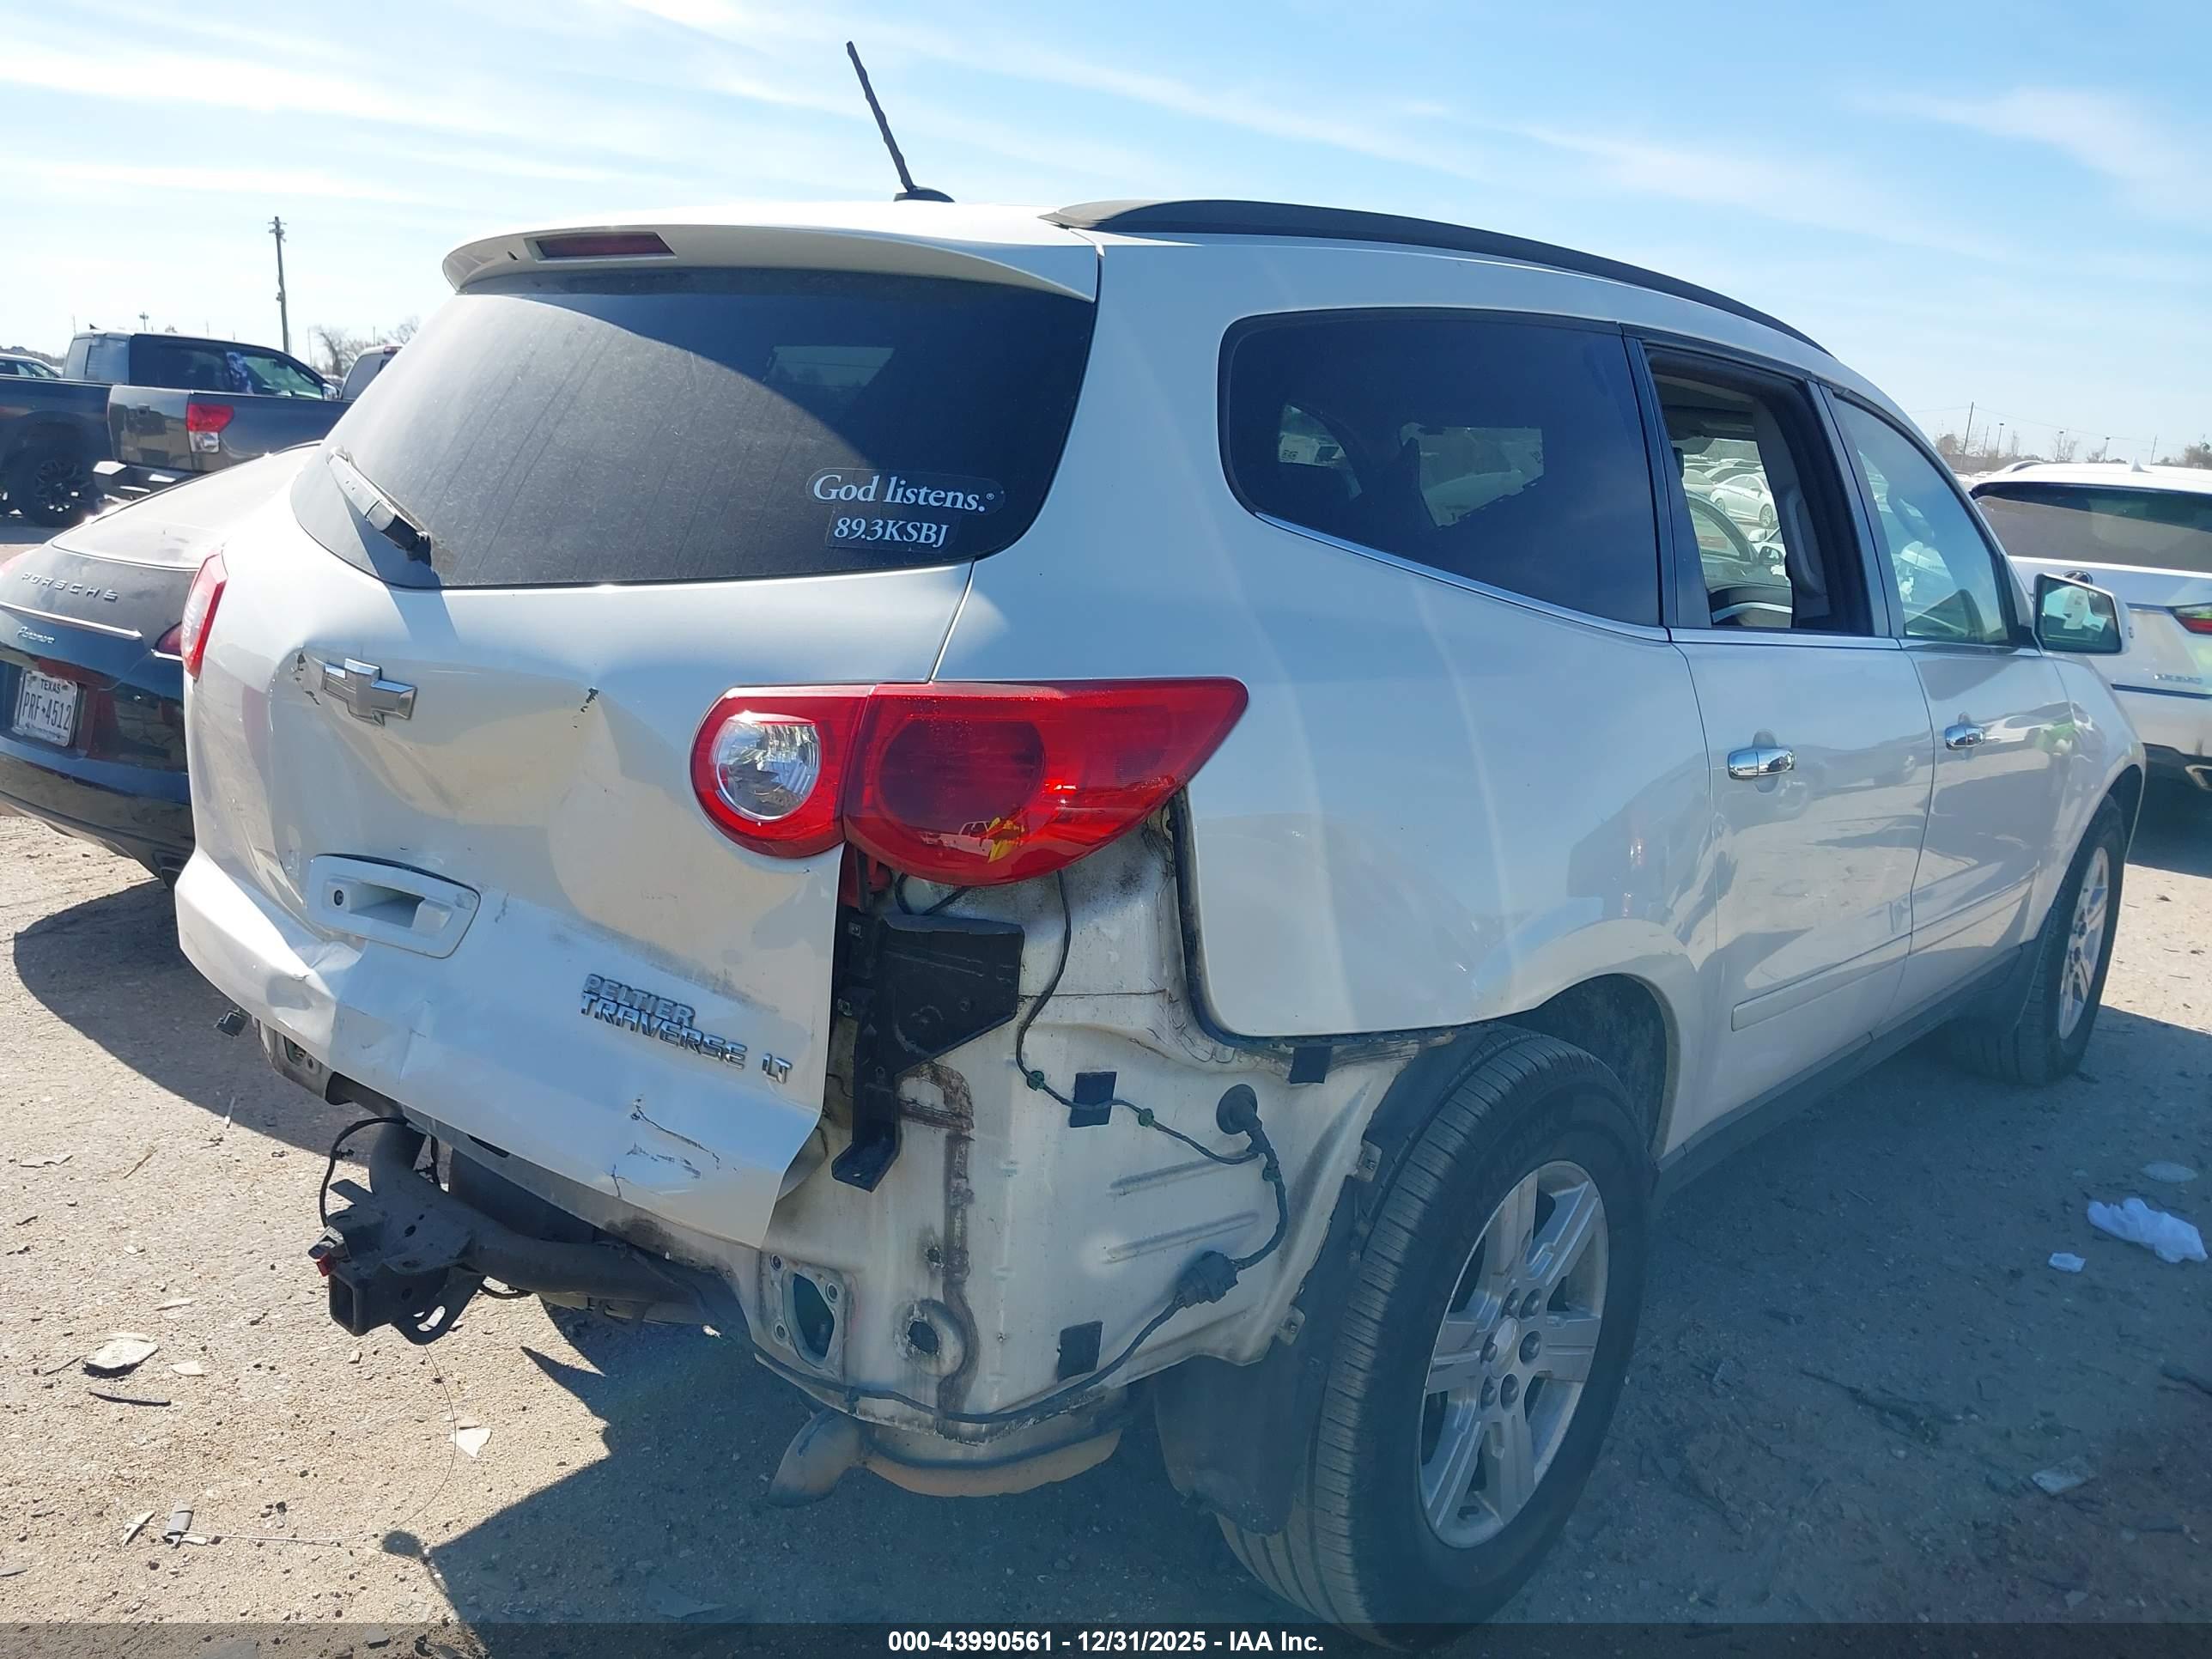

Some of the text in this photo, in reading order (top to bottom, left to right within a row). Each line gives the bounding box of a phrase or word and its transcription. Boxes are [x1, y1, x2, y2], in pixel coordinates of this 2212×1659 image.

[812, 474, 880, 502] God
[21, 571, 119, 603] PORSCHE
[40, 678, 62, 694] TEXAS
[582, 973, 696, 1028] PELTIER
[580, 990, 793, 1085] TRAVERSE LT
